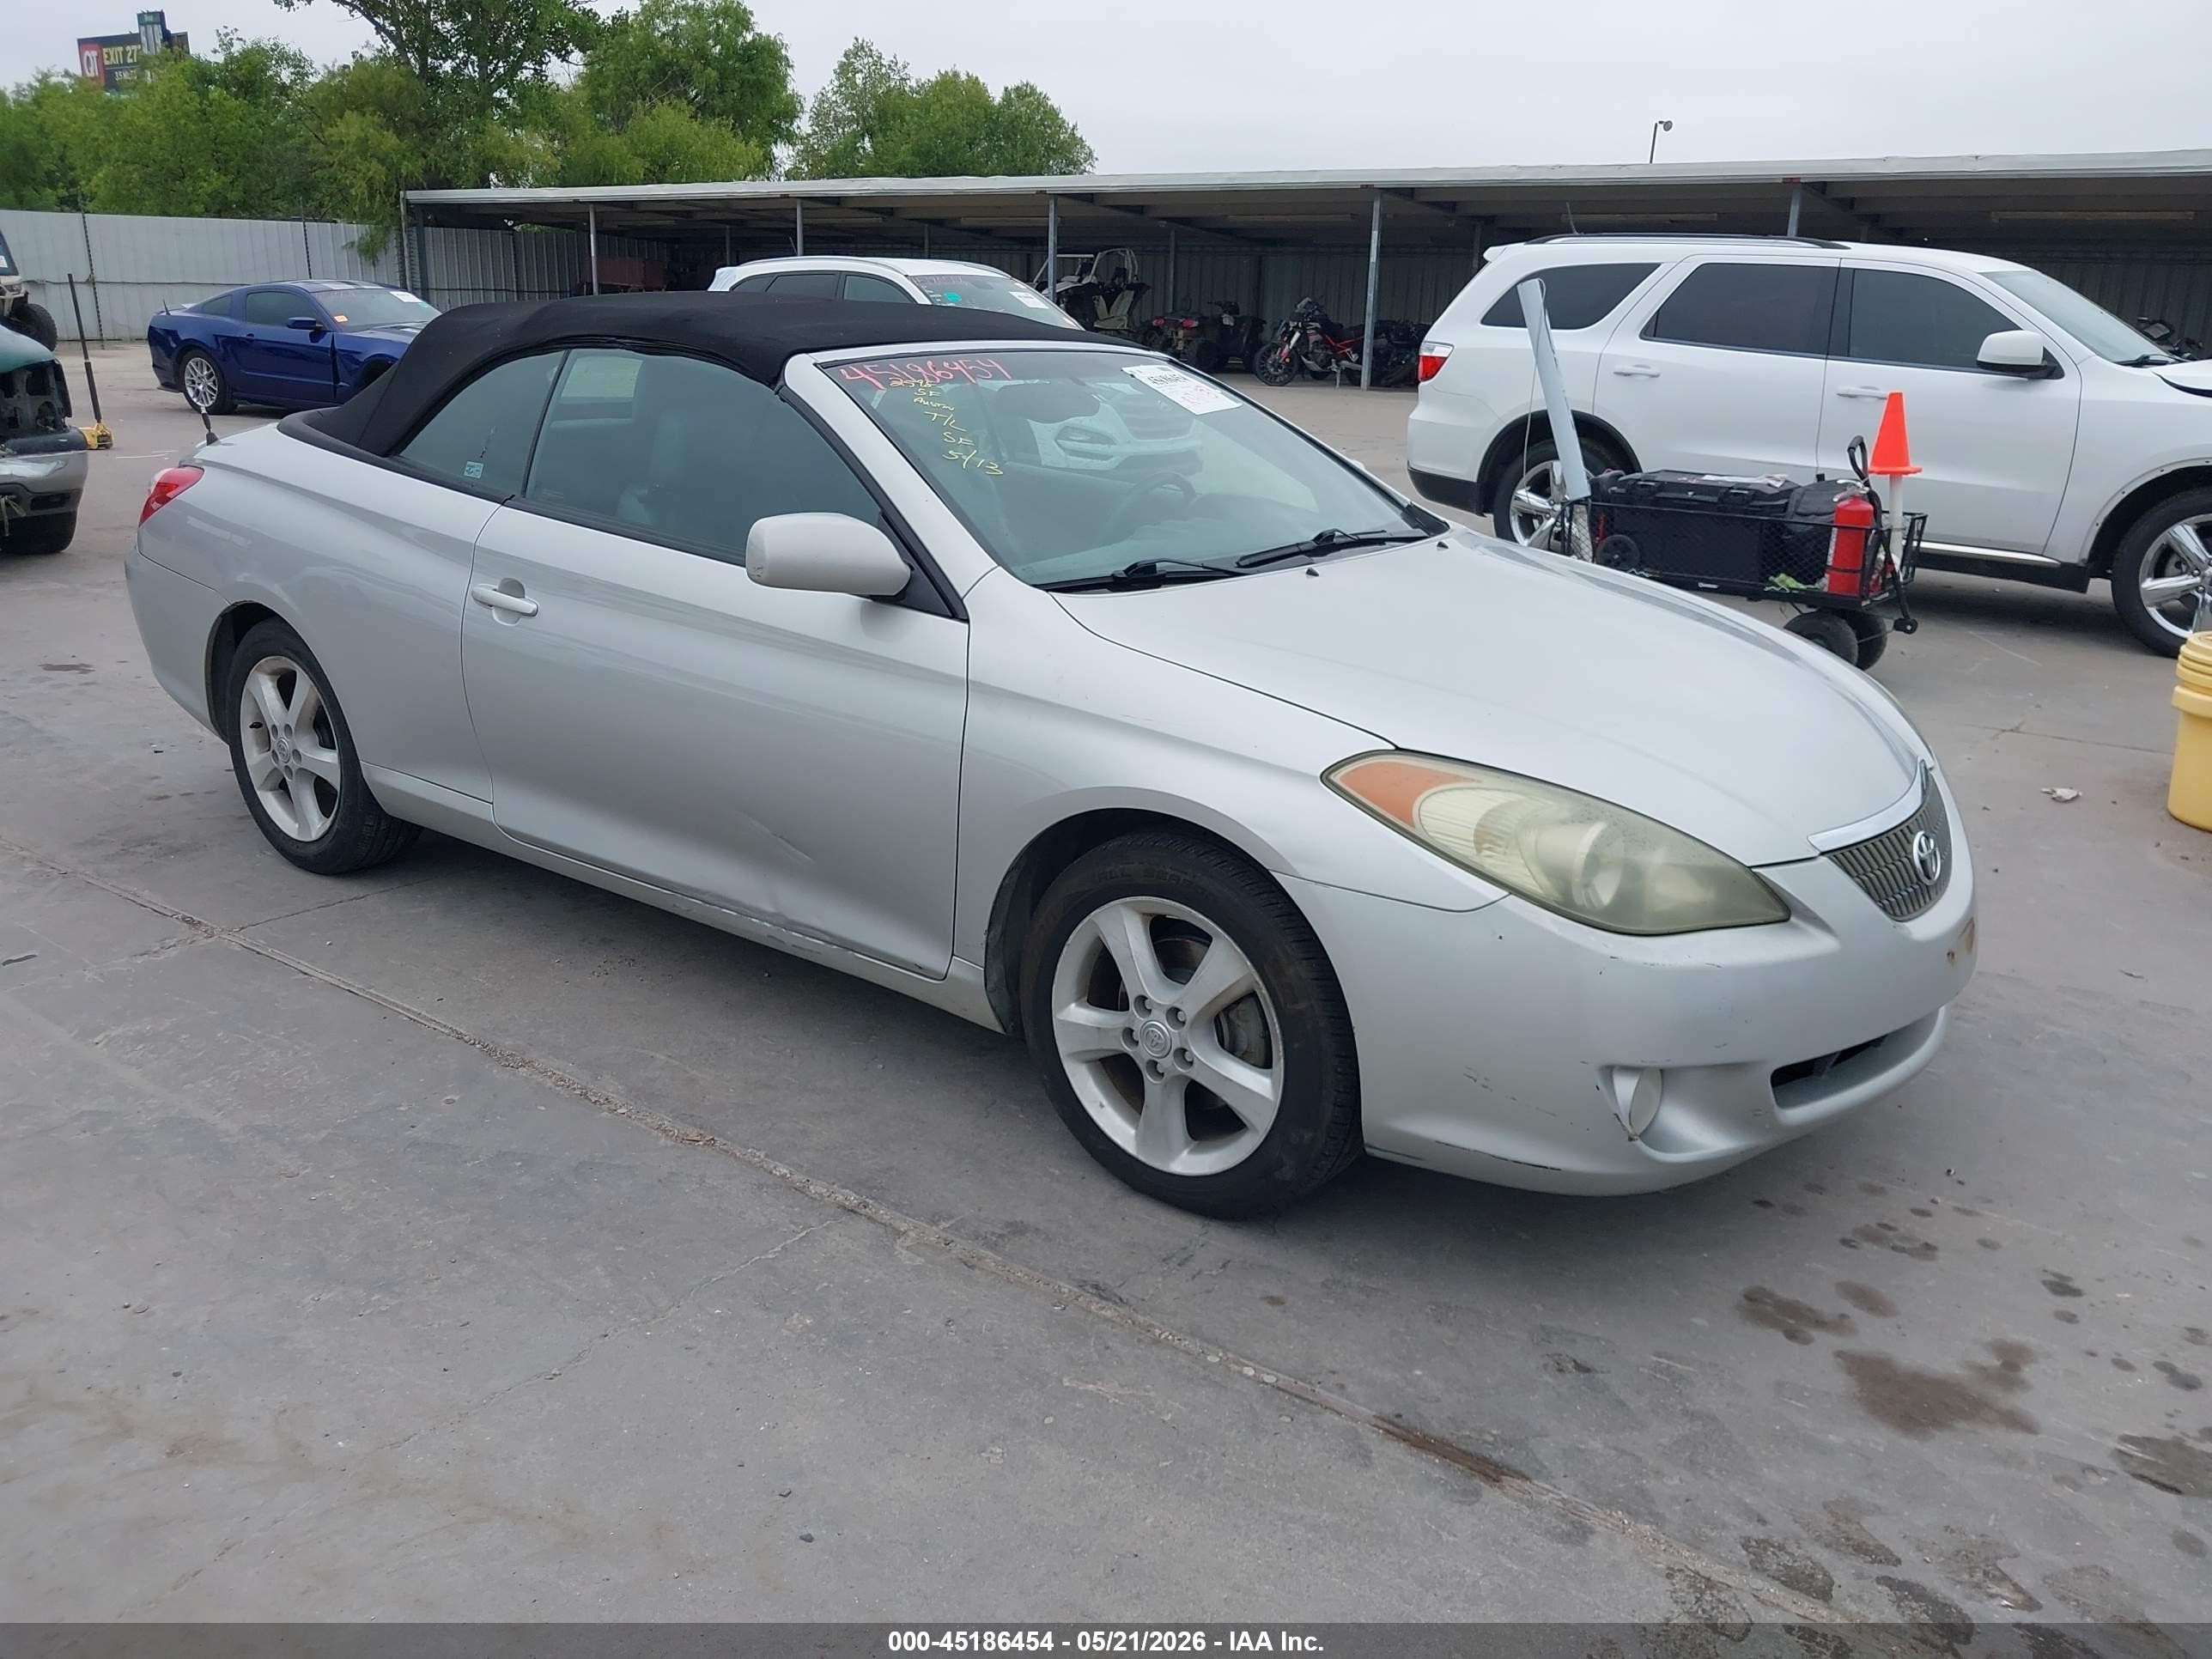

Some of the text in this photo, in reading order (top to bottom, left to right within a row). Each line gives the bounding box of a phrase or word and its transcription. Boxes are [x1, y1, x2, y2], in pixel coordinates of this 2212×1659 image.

[83, 51, 100, 77] QT
[102, 44, 141, 65] EXIT 27
[839, 358, 1012, 391] 45186454
